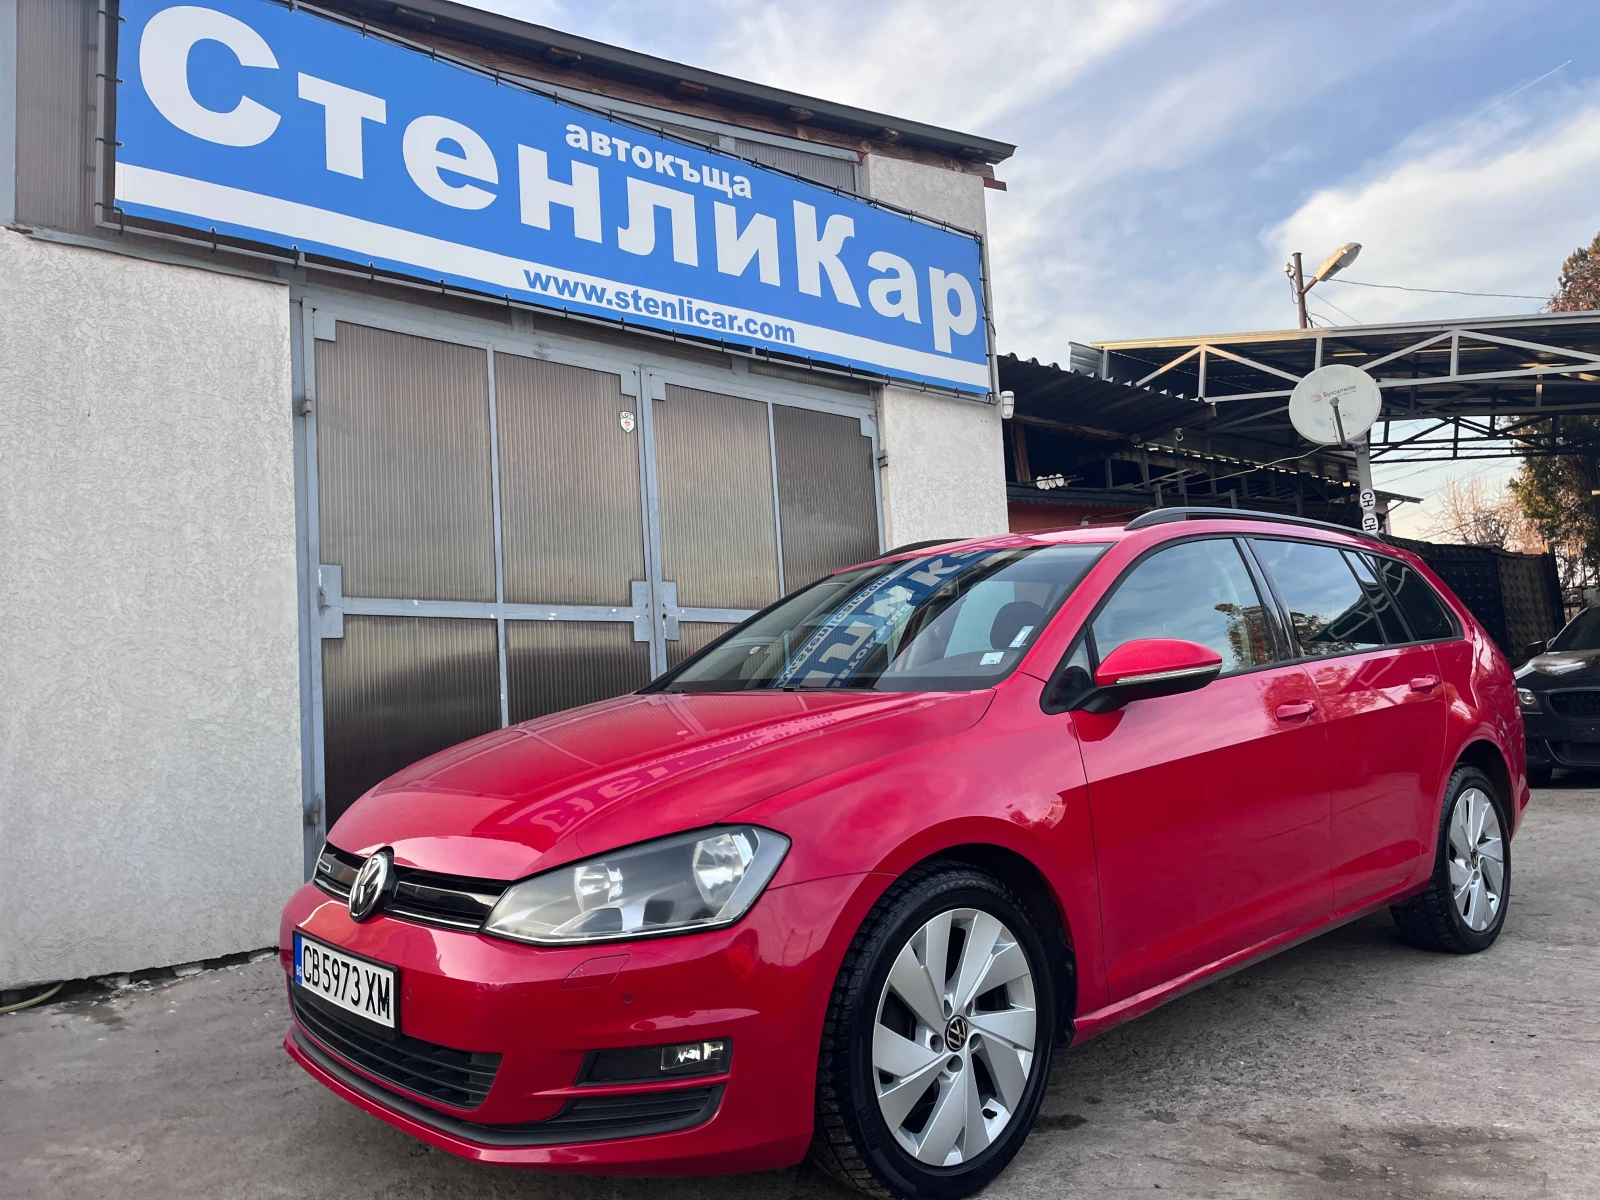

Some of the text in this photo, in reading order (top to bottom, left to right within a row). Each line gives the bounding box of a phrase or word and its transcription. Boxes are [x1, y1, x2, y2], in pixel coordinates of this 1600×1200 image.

[139, 5, 978, 354] СтенлиКар
[565, 123, 753, 199] автокъща
[523, 269, 796, 344] www.stenlicar.com
[1361, 492, 1374, 507] CH
[1364, 517, 1377, 531] CH
[303, 944, 390, 1020] CB 5973 XM
